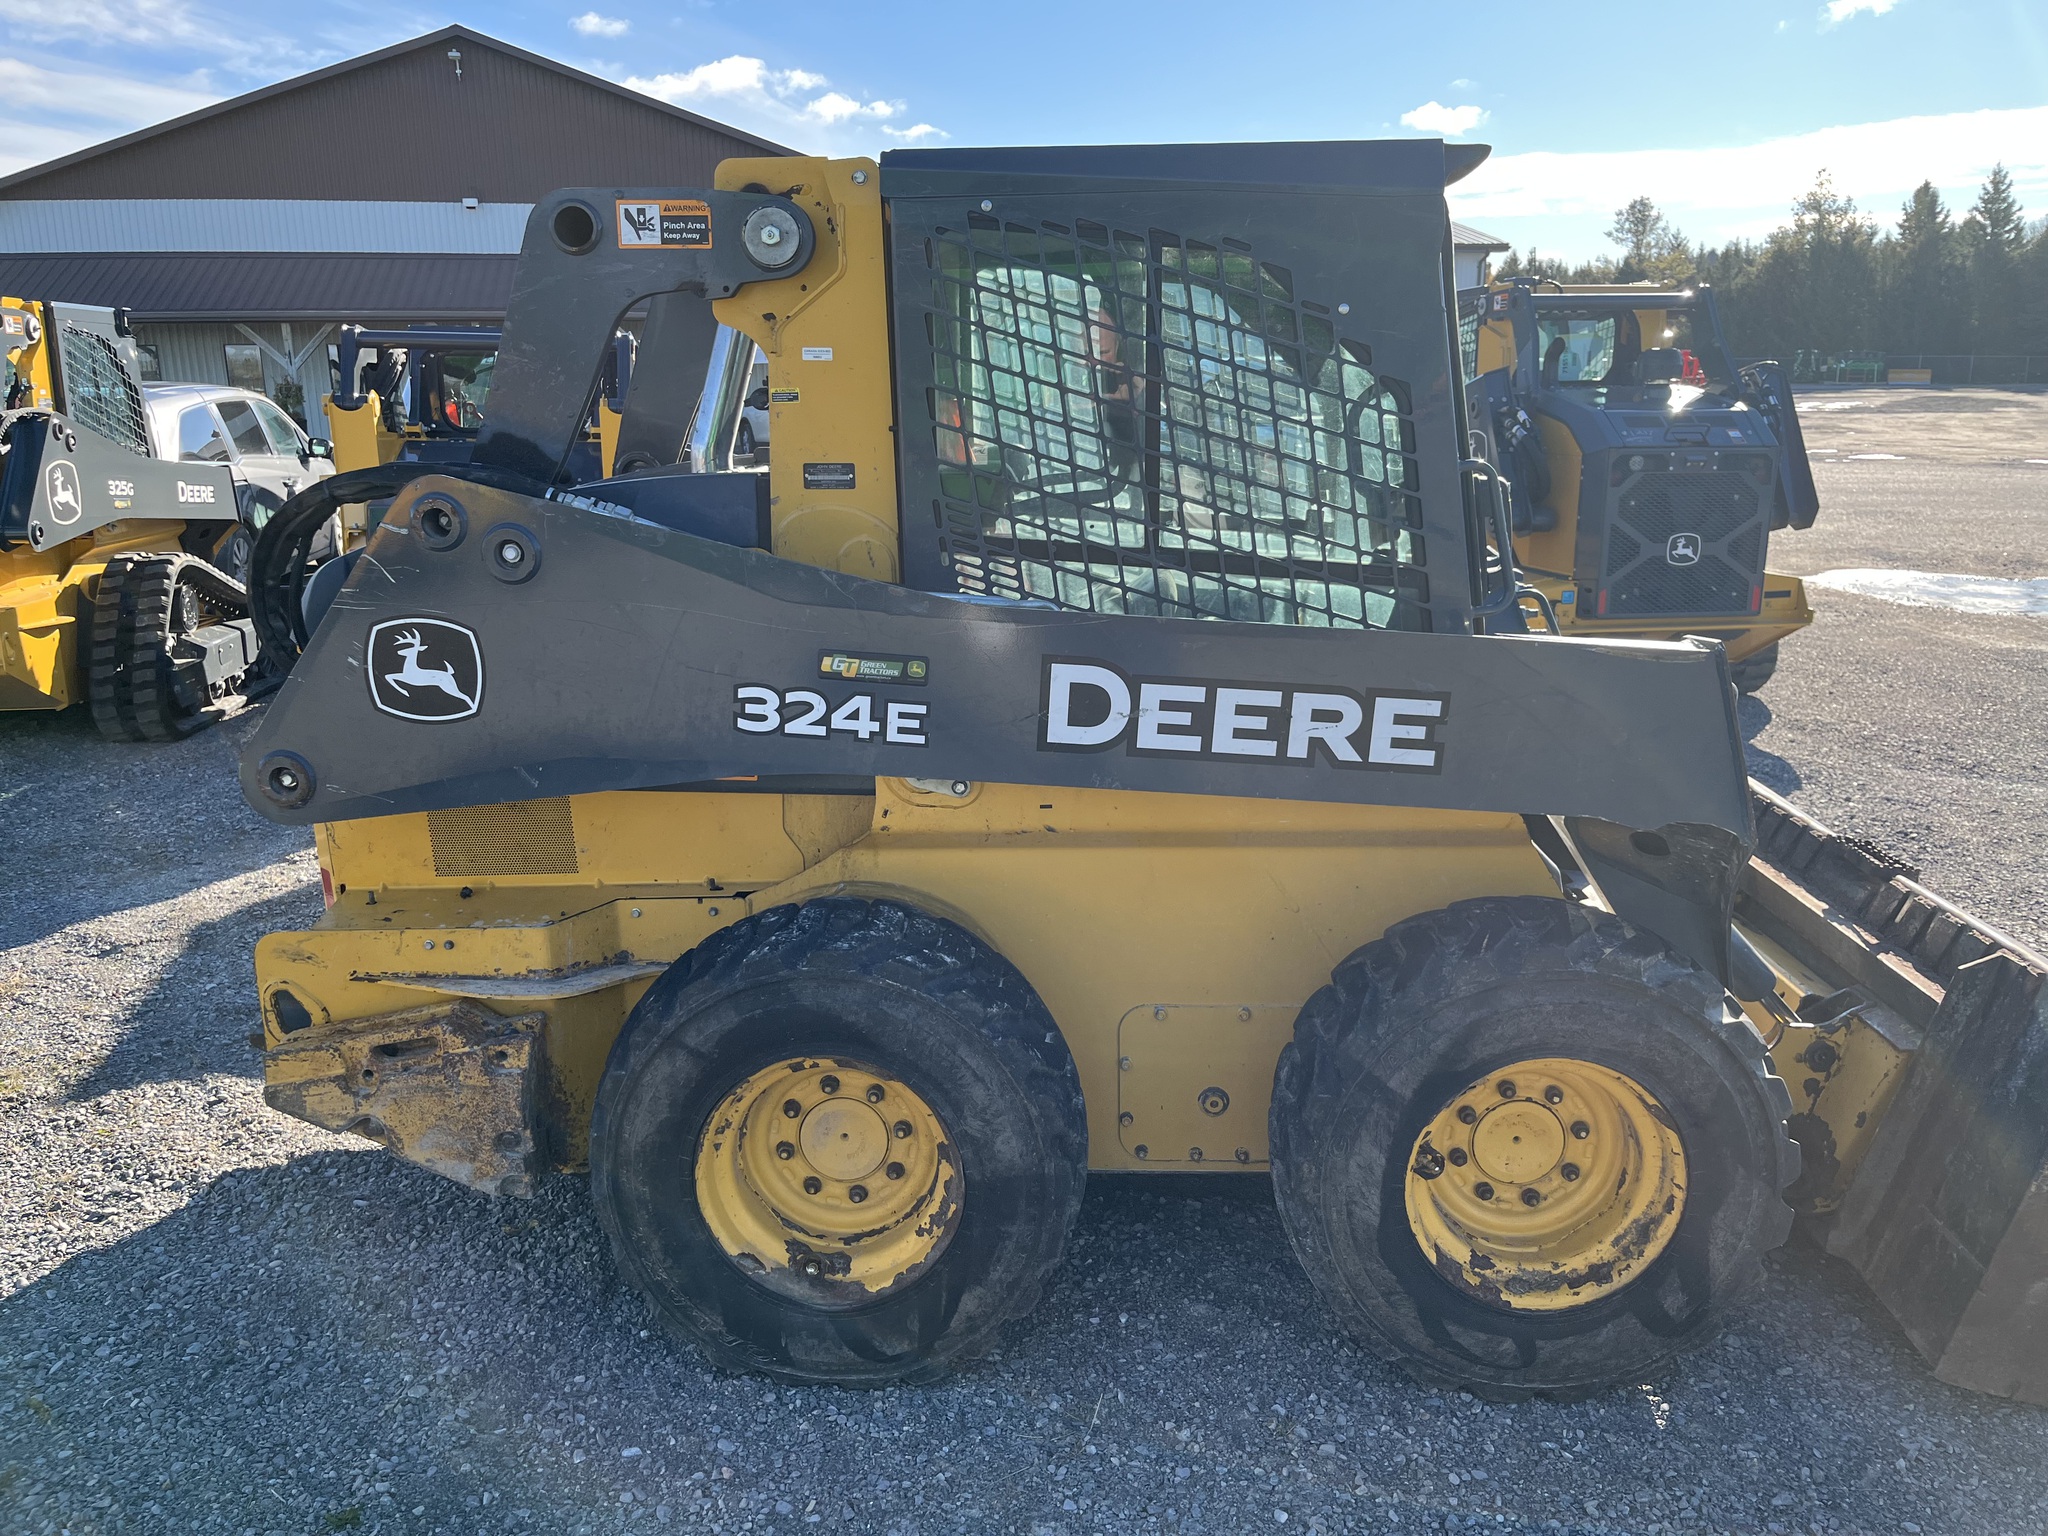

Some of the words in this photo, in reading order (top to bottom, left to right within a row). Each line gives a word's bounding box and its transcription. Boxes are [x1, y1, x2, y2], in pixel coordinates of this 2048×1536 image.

[663, 232, 681, 240] Keep
[682, 232, 700, 240] Away
[108, 480, 134, 496] 325G
[177, 480, 215, 503] DEERE
[860, 660, 887, 669] GREEN
[860, 667, 899, 676] TRACTORS
[736, 687, 927, 745] 324E
[1046, 662, 1443, 767] DEERE
